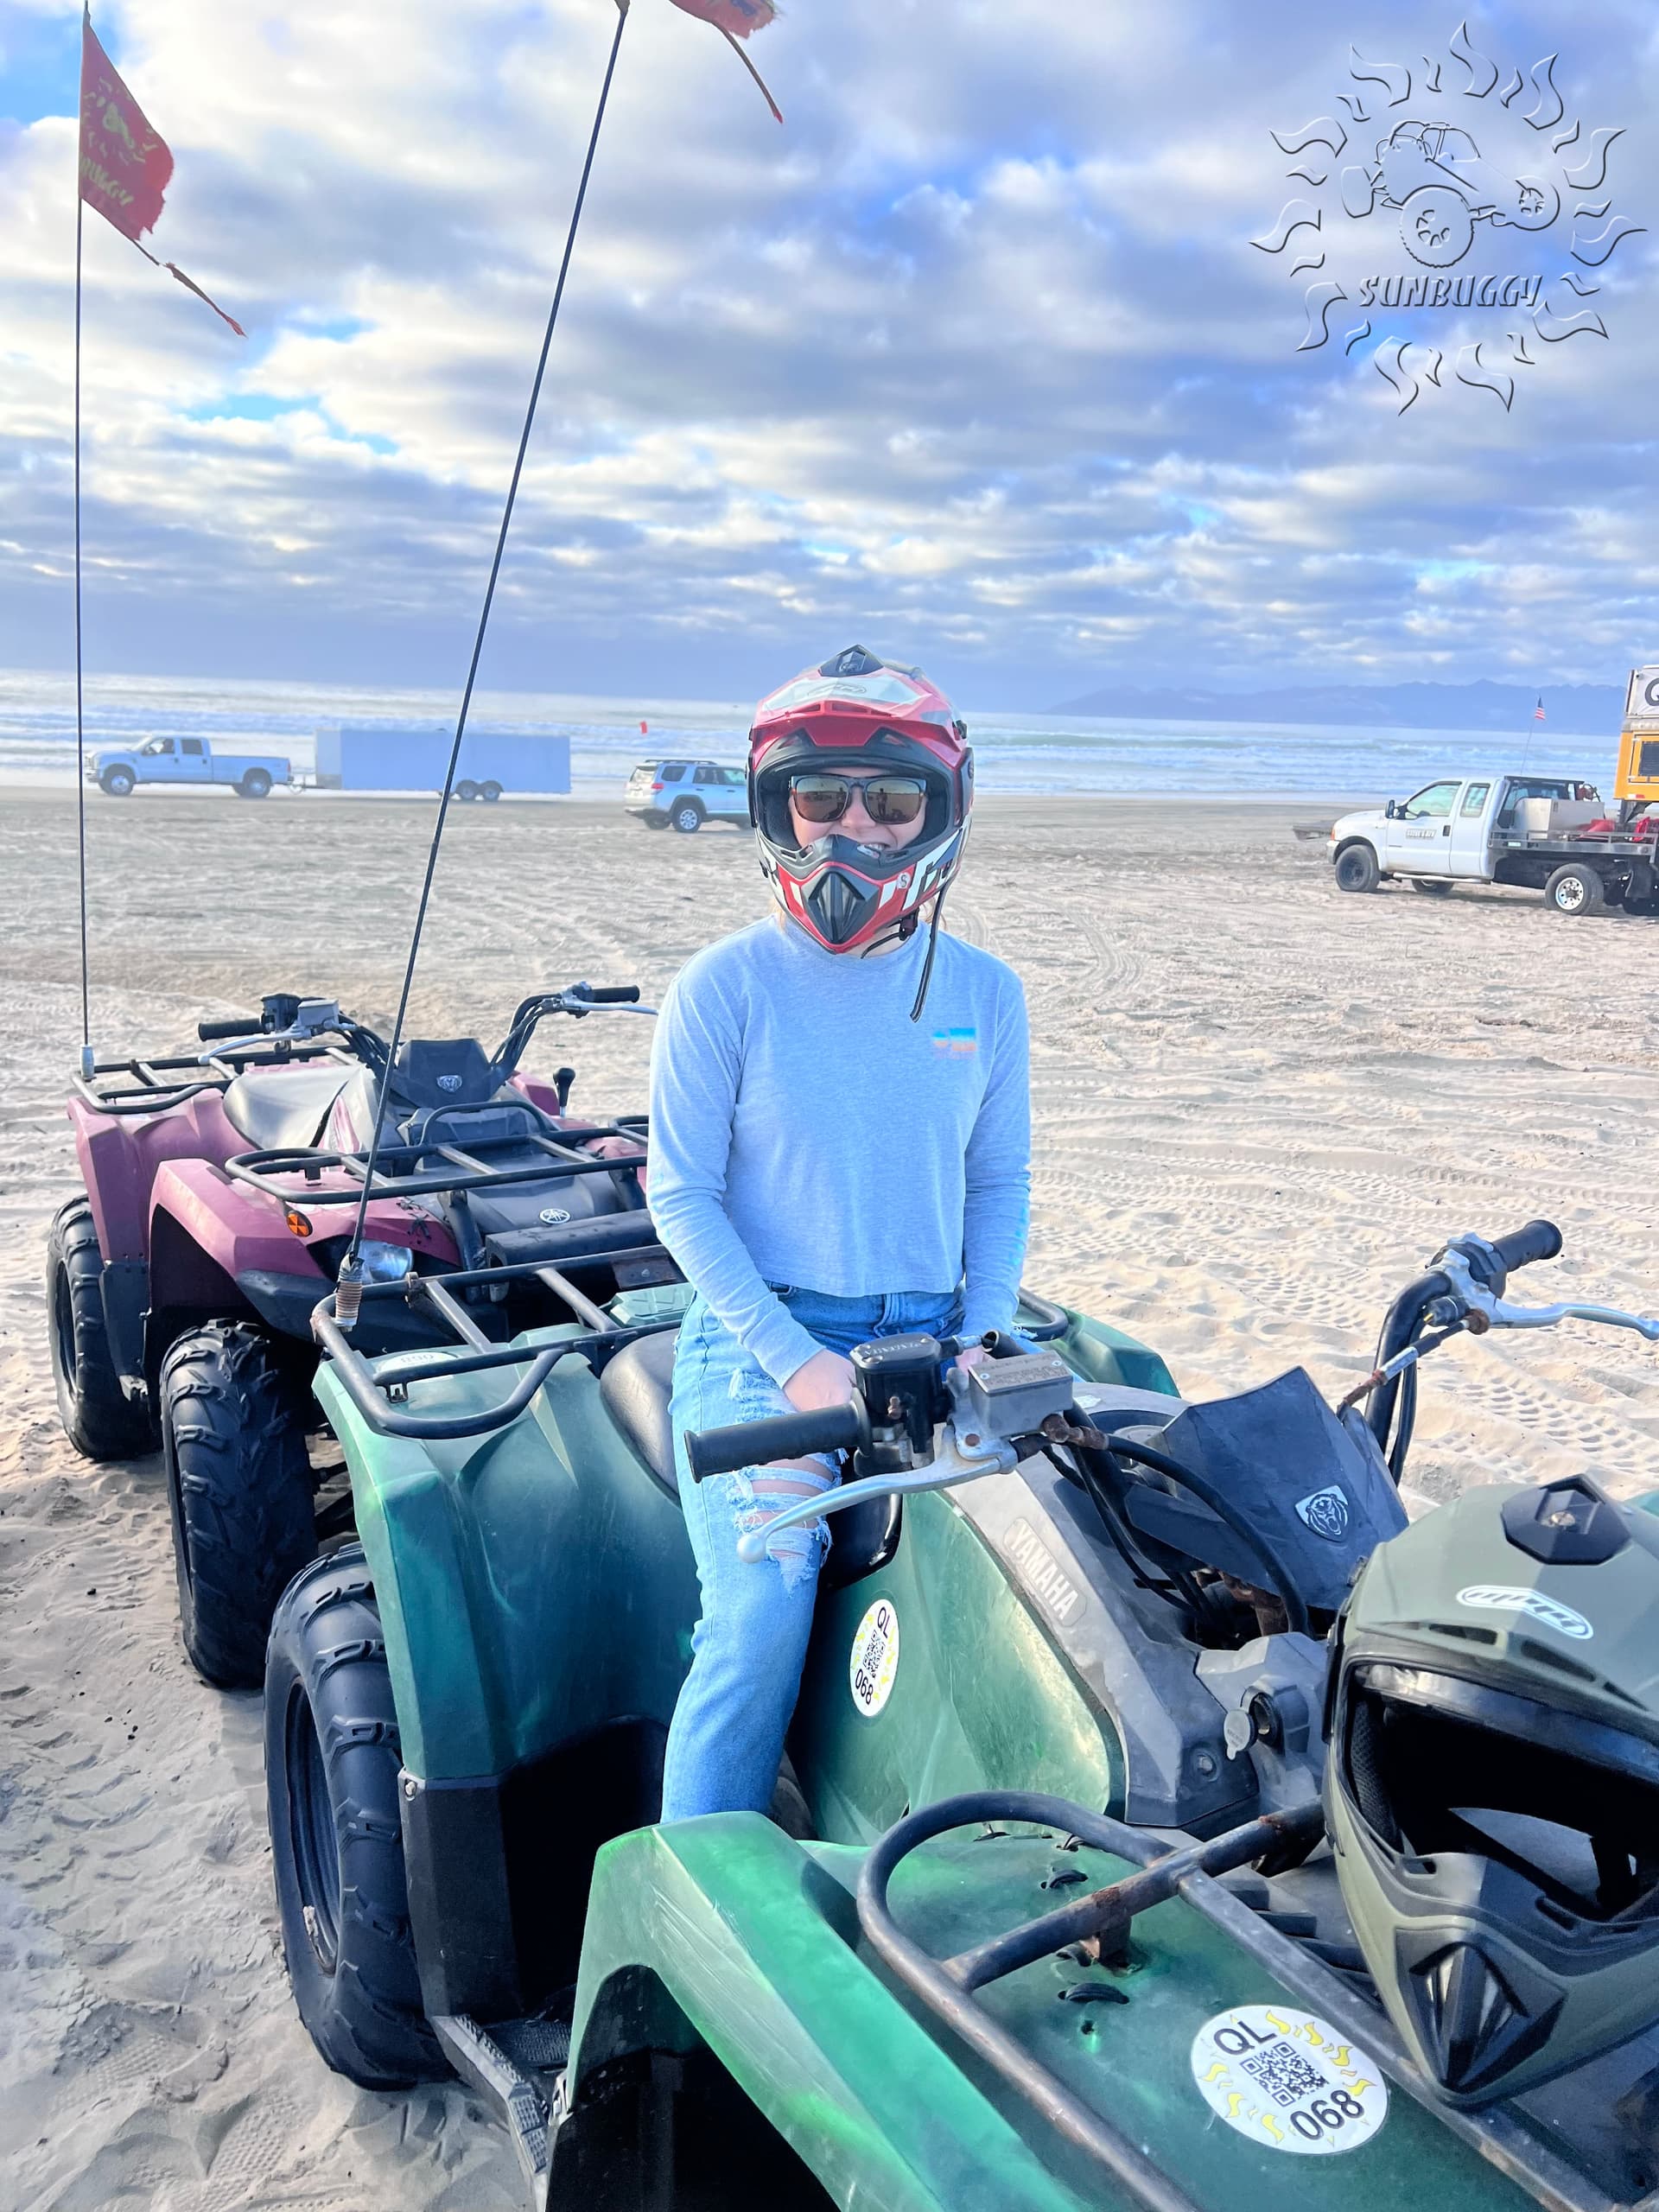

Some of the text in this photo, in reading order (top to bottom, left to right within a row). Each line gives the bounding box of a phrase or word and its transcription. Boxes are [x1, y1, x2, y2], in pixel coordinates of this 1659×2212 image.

[900, 874, 907, 888] S
[1010, 1523, 1078, 1620] YAMAHA
[877, 1606, 890, 1640] QL
[855, 1668, 874, 1706] 068
[1213, 2020, 1278, 2056] QL
[1289, 2088, 1365, 2141] 068
